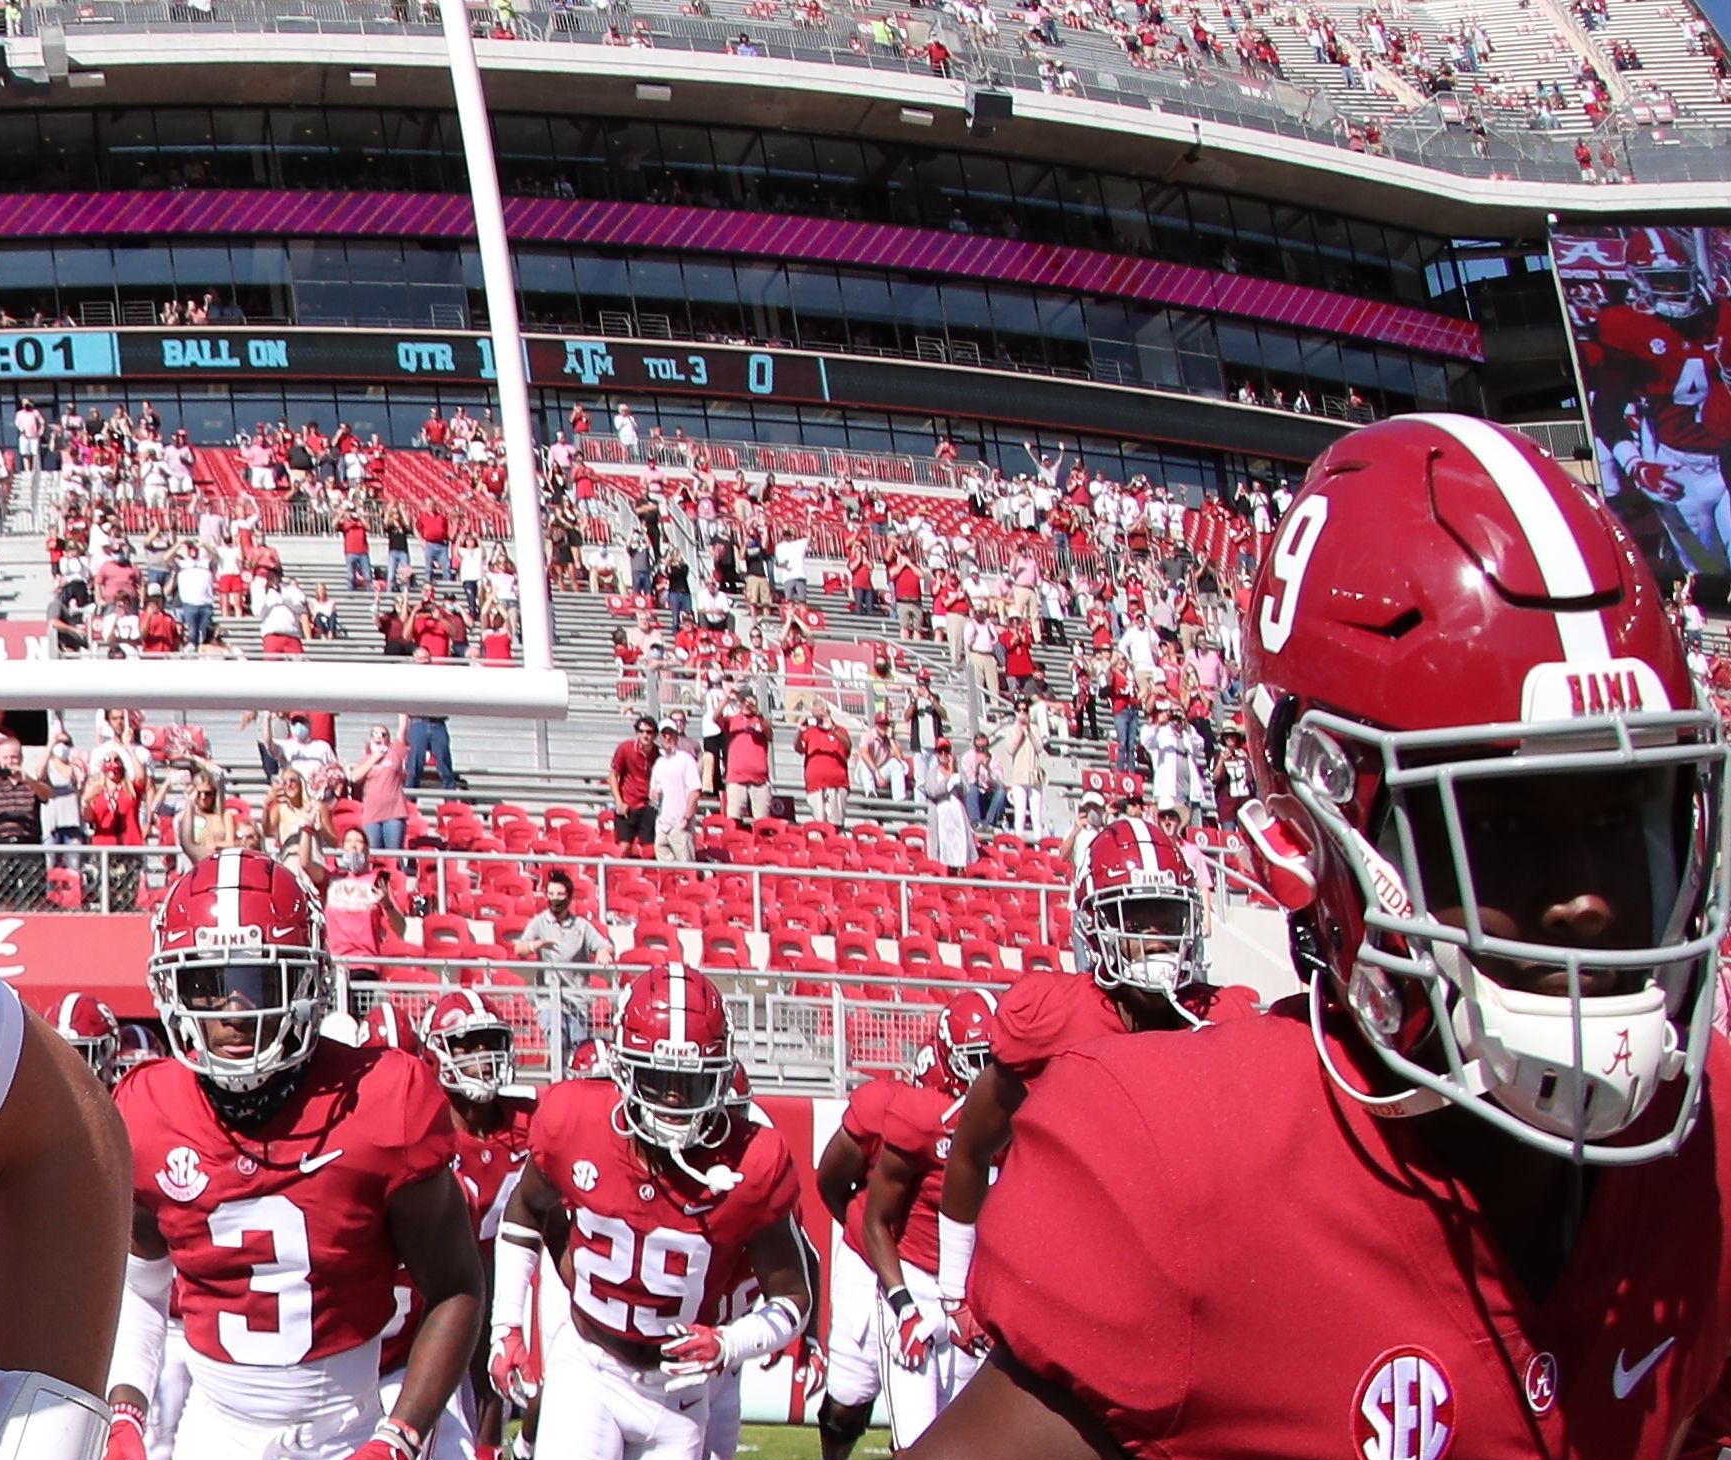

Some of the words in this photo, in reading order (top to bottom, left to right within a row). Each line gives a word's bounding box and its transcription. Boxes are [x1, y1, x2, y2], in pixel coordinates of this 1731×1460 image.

[162, 339, 240, 368] BALL
[248, 339, 290, 368] ON
[397, 341, 456, 372] QTR
[644, 357, 686, 381] TOL
[688, 356, 709, 385] 3
[748, 354, 774, 394] 0
[1673, 358, 1710, 423] 4
[1260, 495, 1328, 654] 9
[1565, 670, 1644, 718] BAMA
[212, 933, 245, 946] BAMA
[665, 1046, 689, 1056] BAMA
[166, 1146, 200, 1187] SEC
[207, 1194, 314, 1368] 3
[571, 1207, 712, 1337] 29
